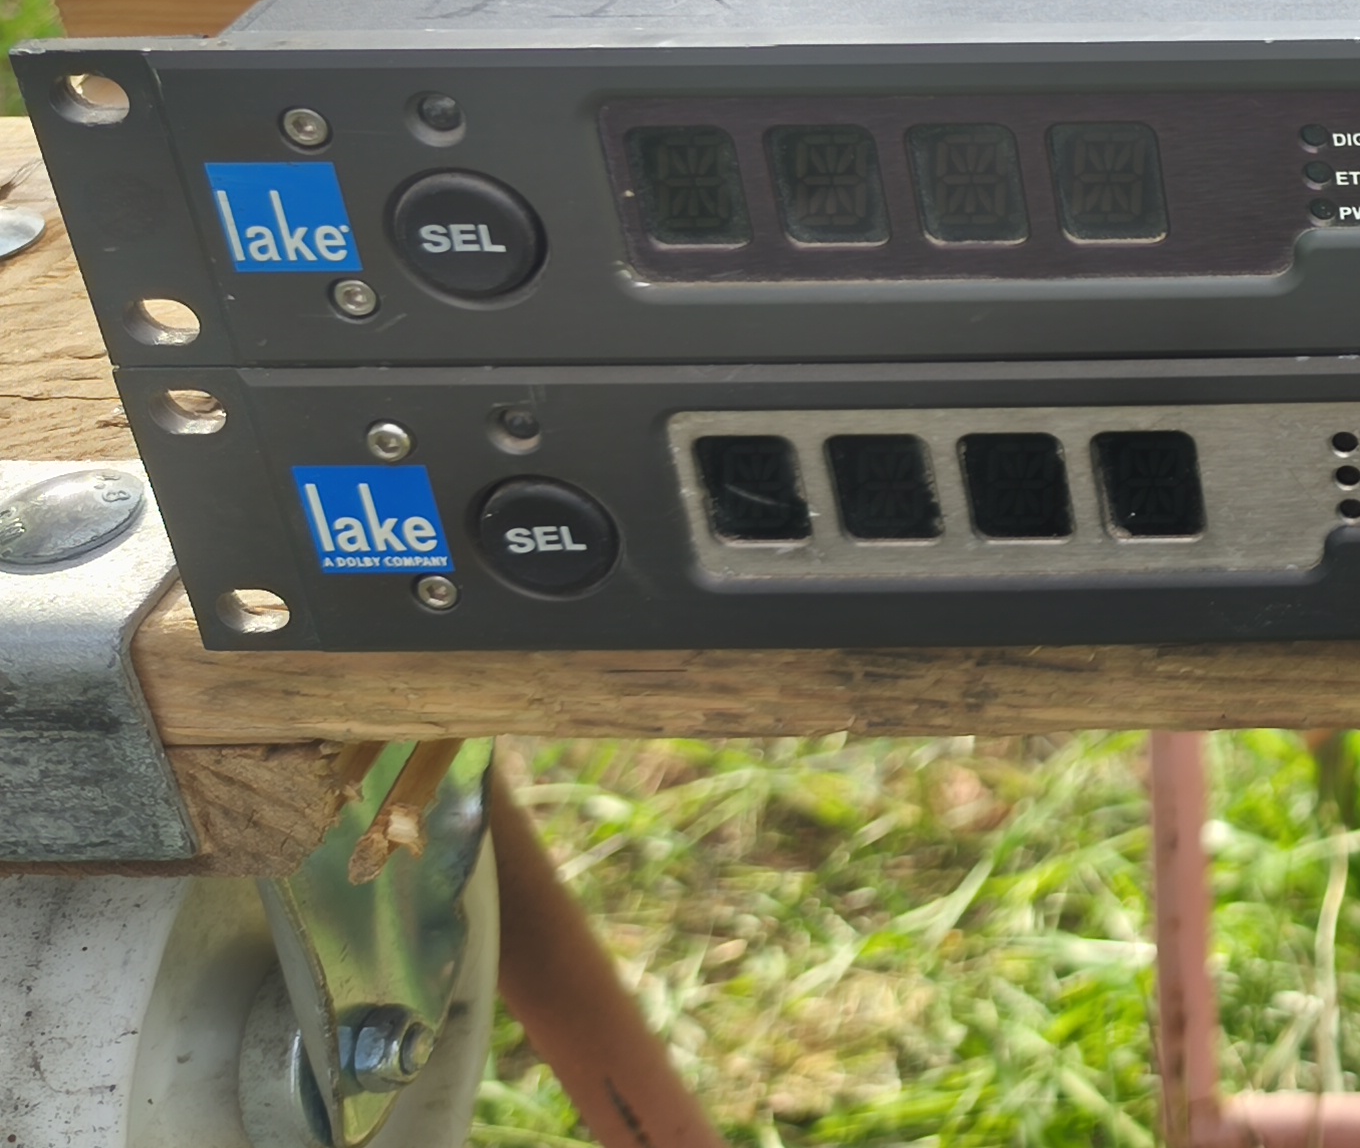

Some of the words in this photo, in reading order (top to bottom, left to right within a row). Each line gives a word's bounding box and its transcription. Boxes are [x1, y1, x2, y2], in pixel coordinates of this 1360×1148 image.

[215, 189, 350, 263] lake
[419, 223, 507, 253] SEL
[304, 482, 438, 552] lake
[505, 525, 587, 554] SEL
[323, 556, 335, 568] A
[336, 556, 381, 568] DOLBY
[383, 555, 449, 568] COMPANY
